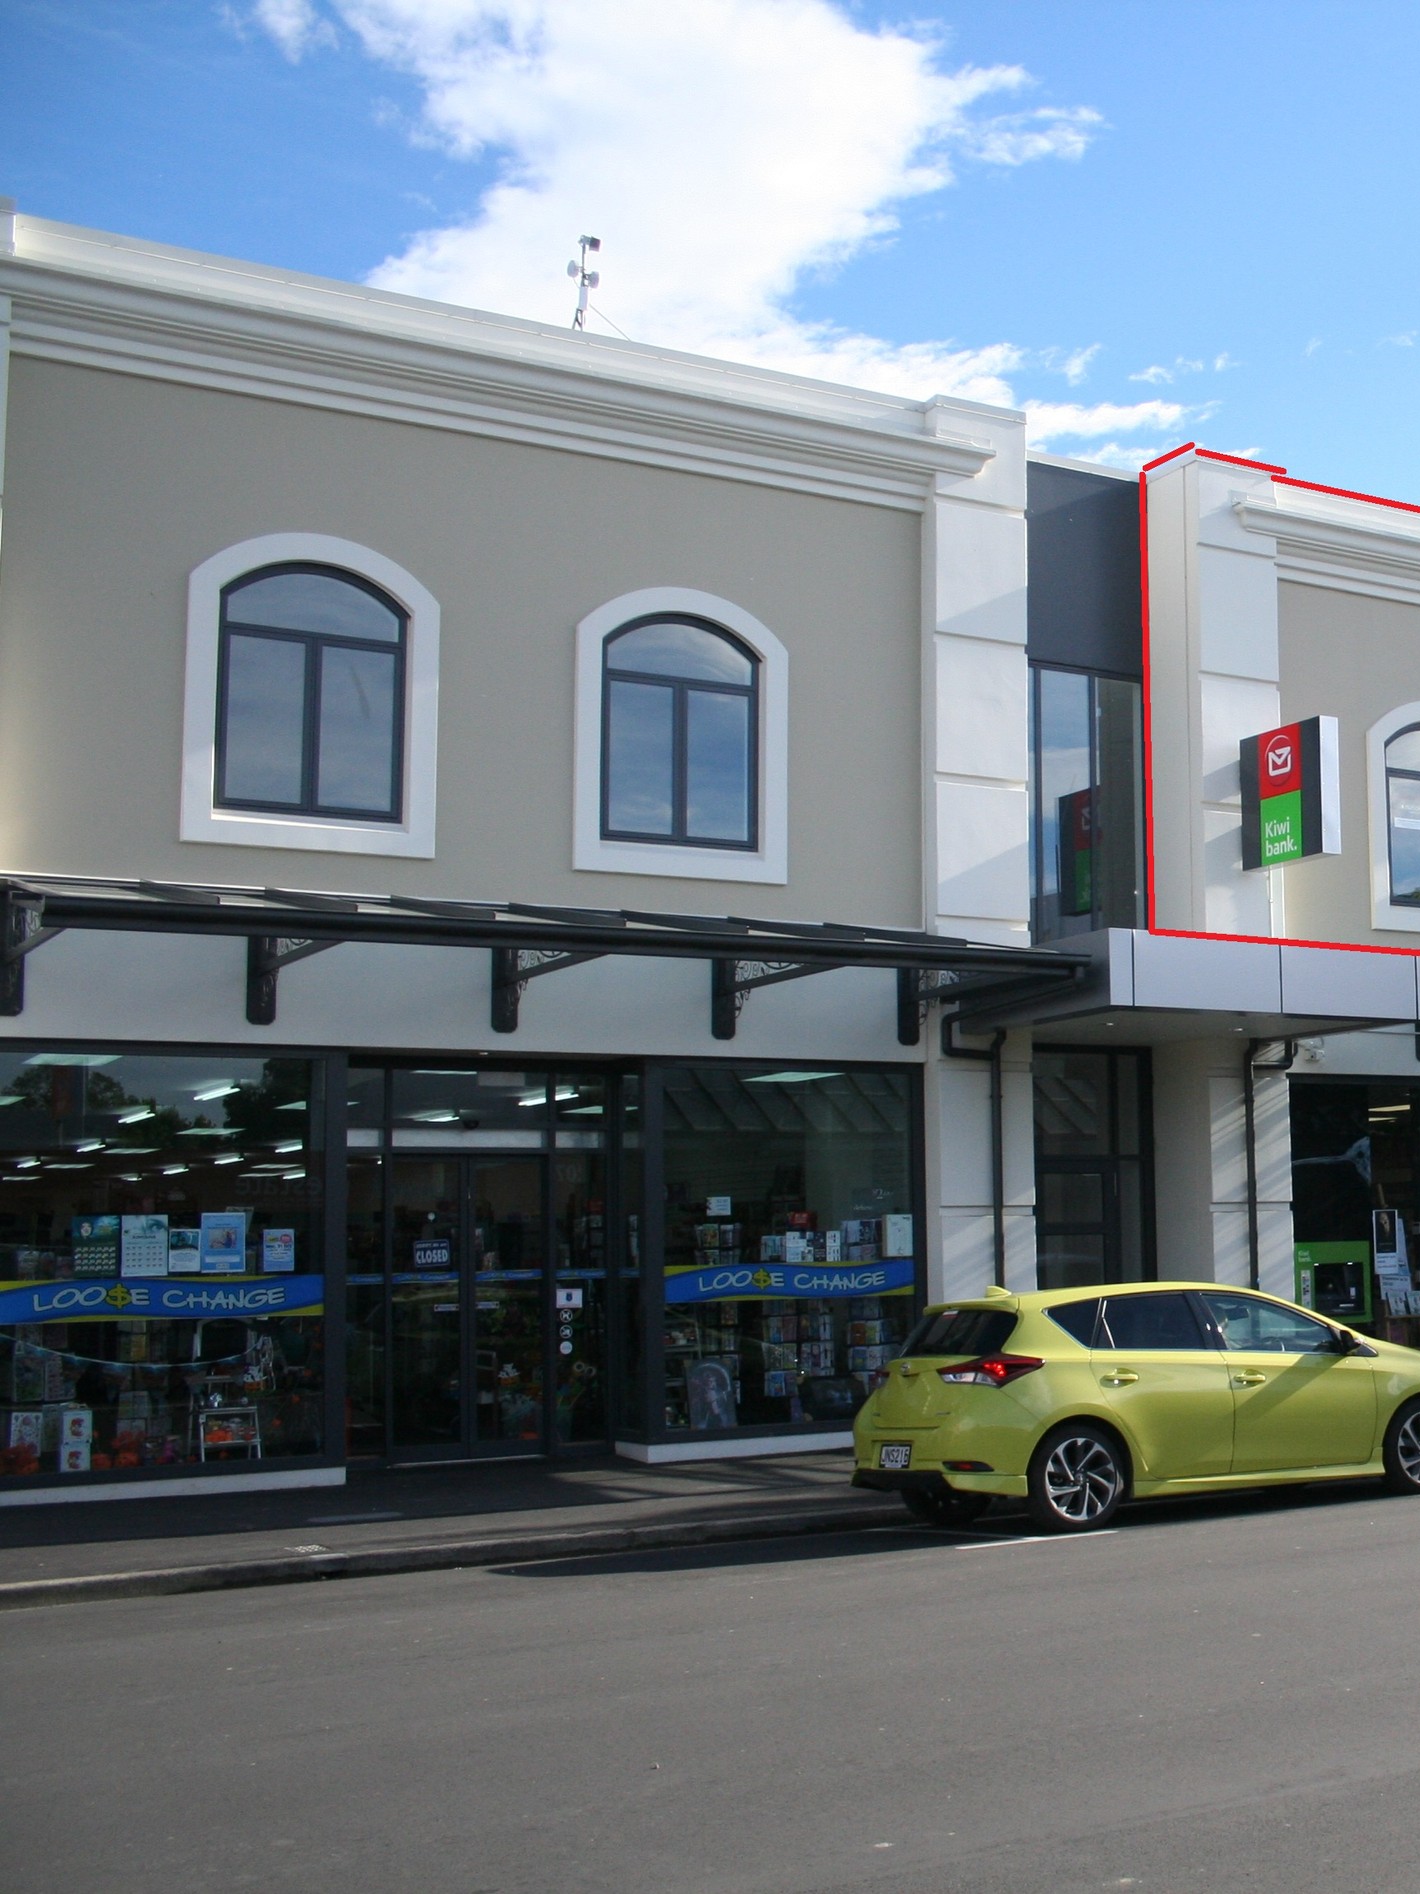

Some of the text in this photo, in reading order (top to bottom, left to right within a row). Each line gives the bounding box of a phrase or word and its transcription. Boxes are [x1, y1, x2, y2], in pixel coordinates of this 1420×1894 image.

[1265, 817, 1291, 838] Kiwi
[416, 1249, 448, 1264] CLOSED
[793, 1271, 886, 1291] CHANGE
[162, 1286, 285, 1311] CHANGE
